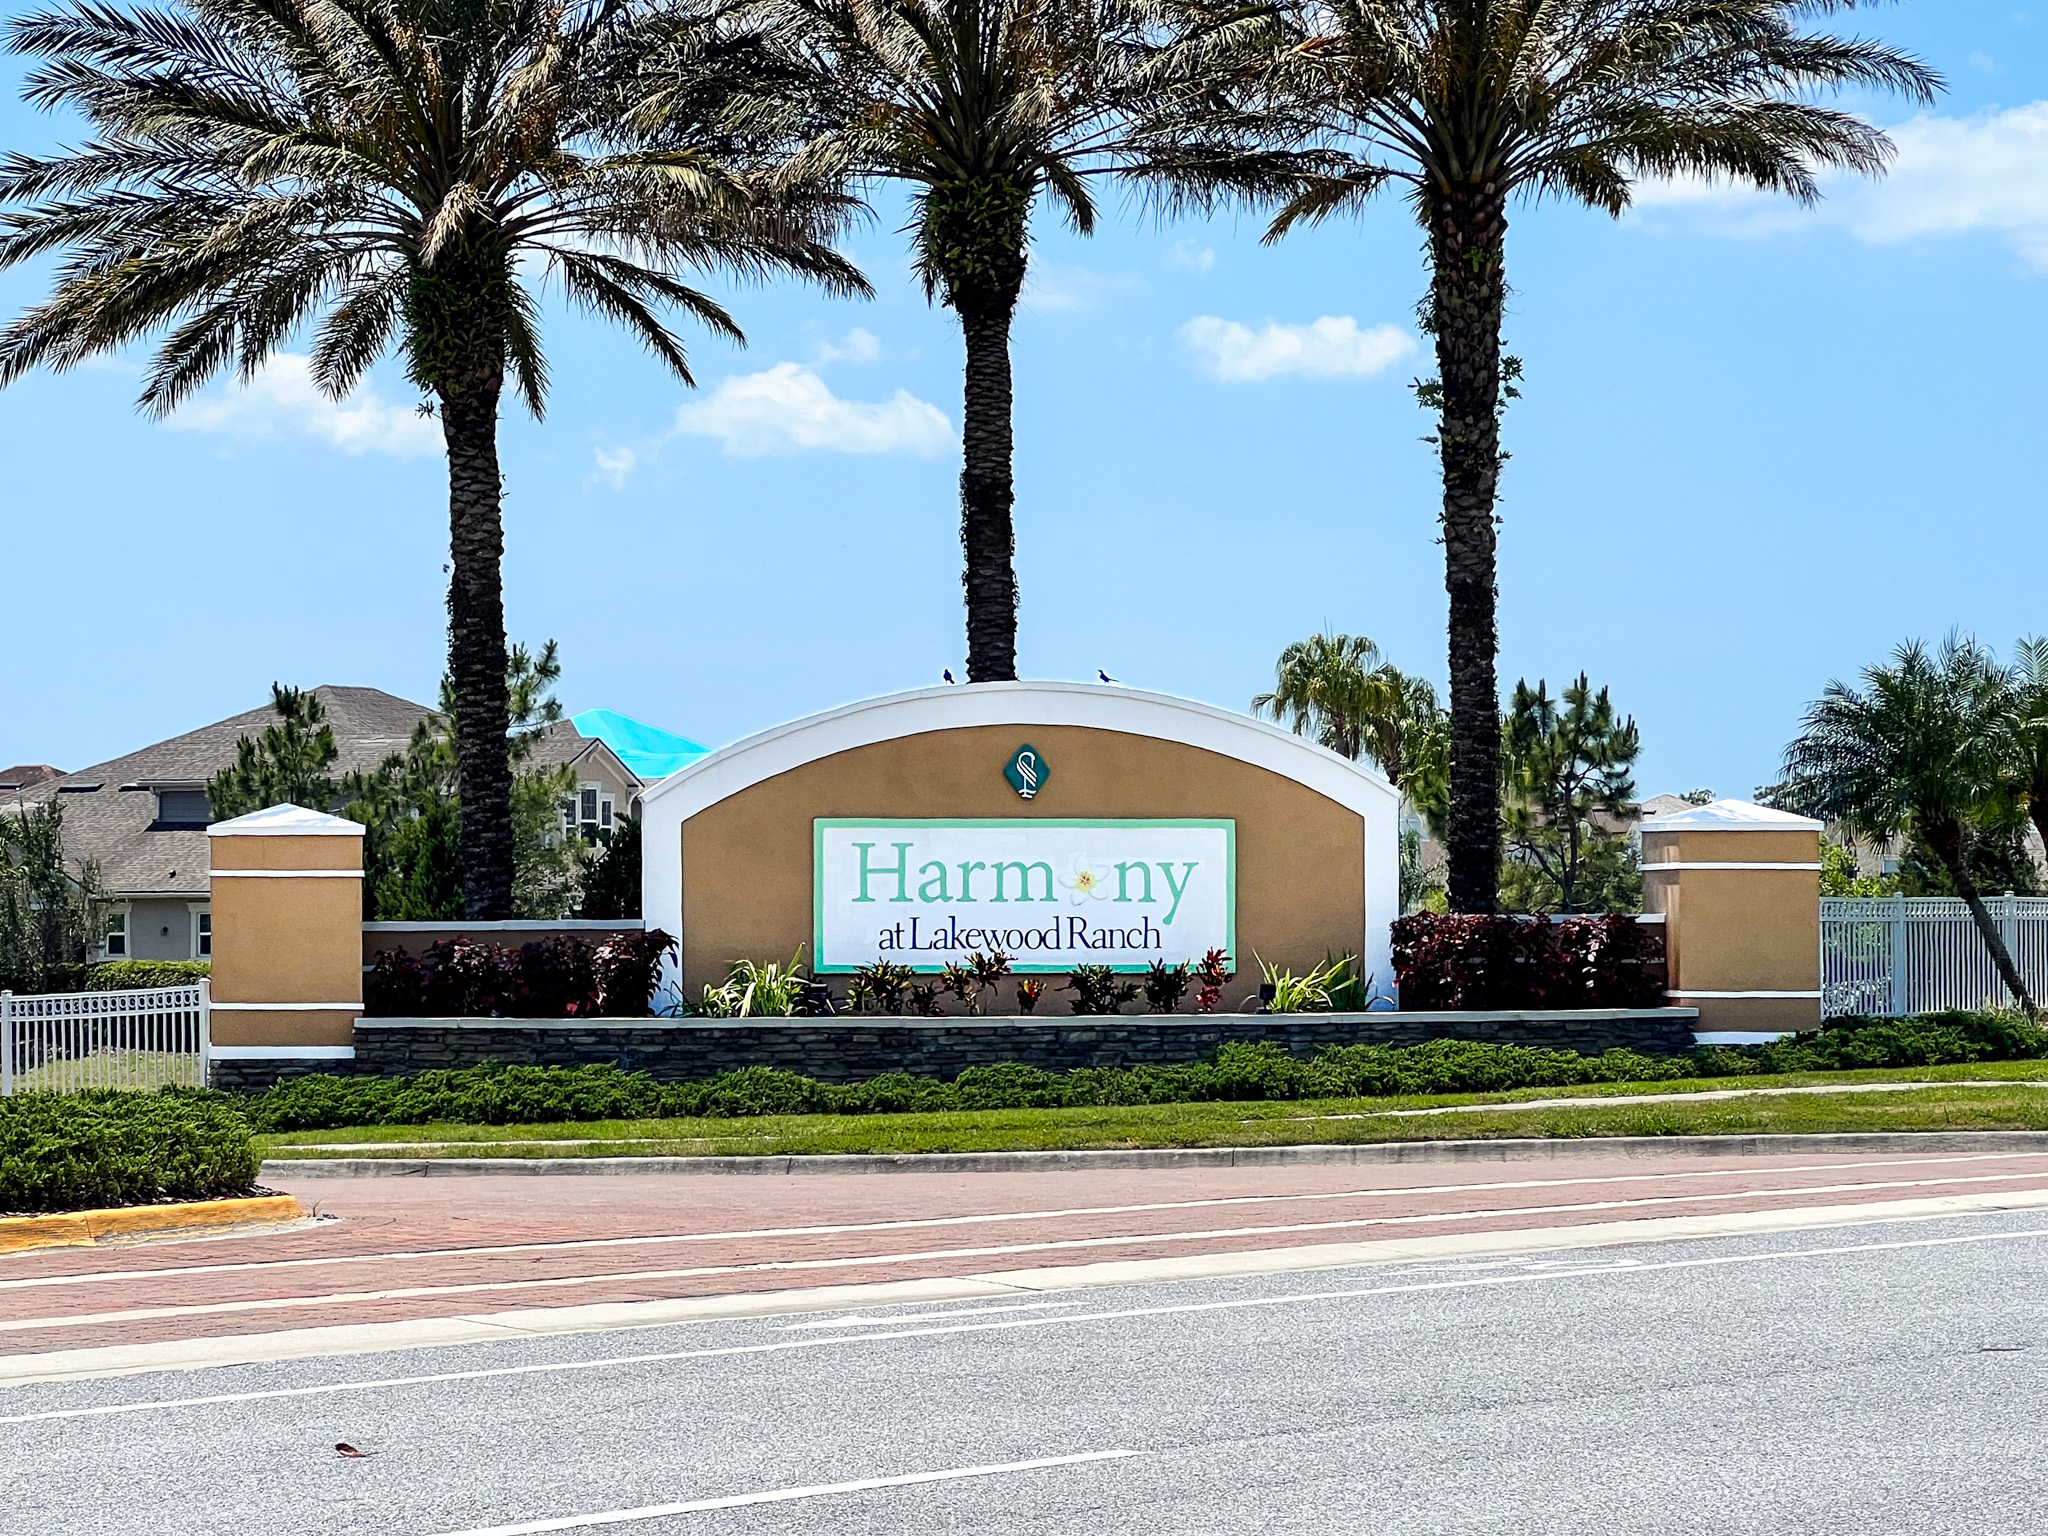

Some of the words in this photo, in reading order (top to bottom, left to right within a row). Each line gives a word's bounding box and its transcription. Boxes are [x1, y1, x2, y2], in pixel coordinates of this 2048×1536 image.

[878, 921, 906, 950] at
[909, 916, 1061, 951] Lakewood
[1066, 916, 1162, 950] Ranch
